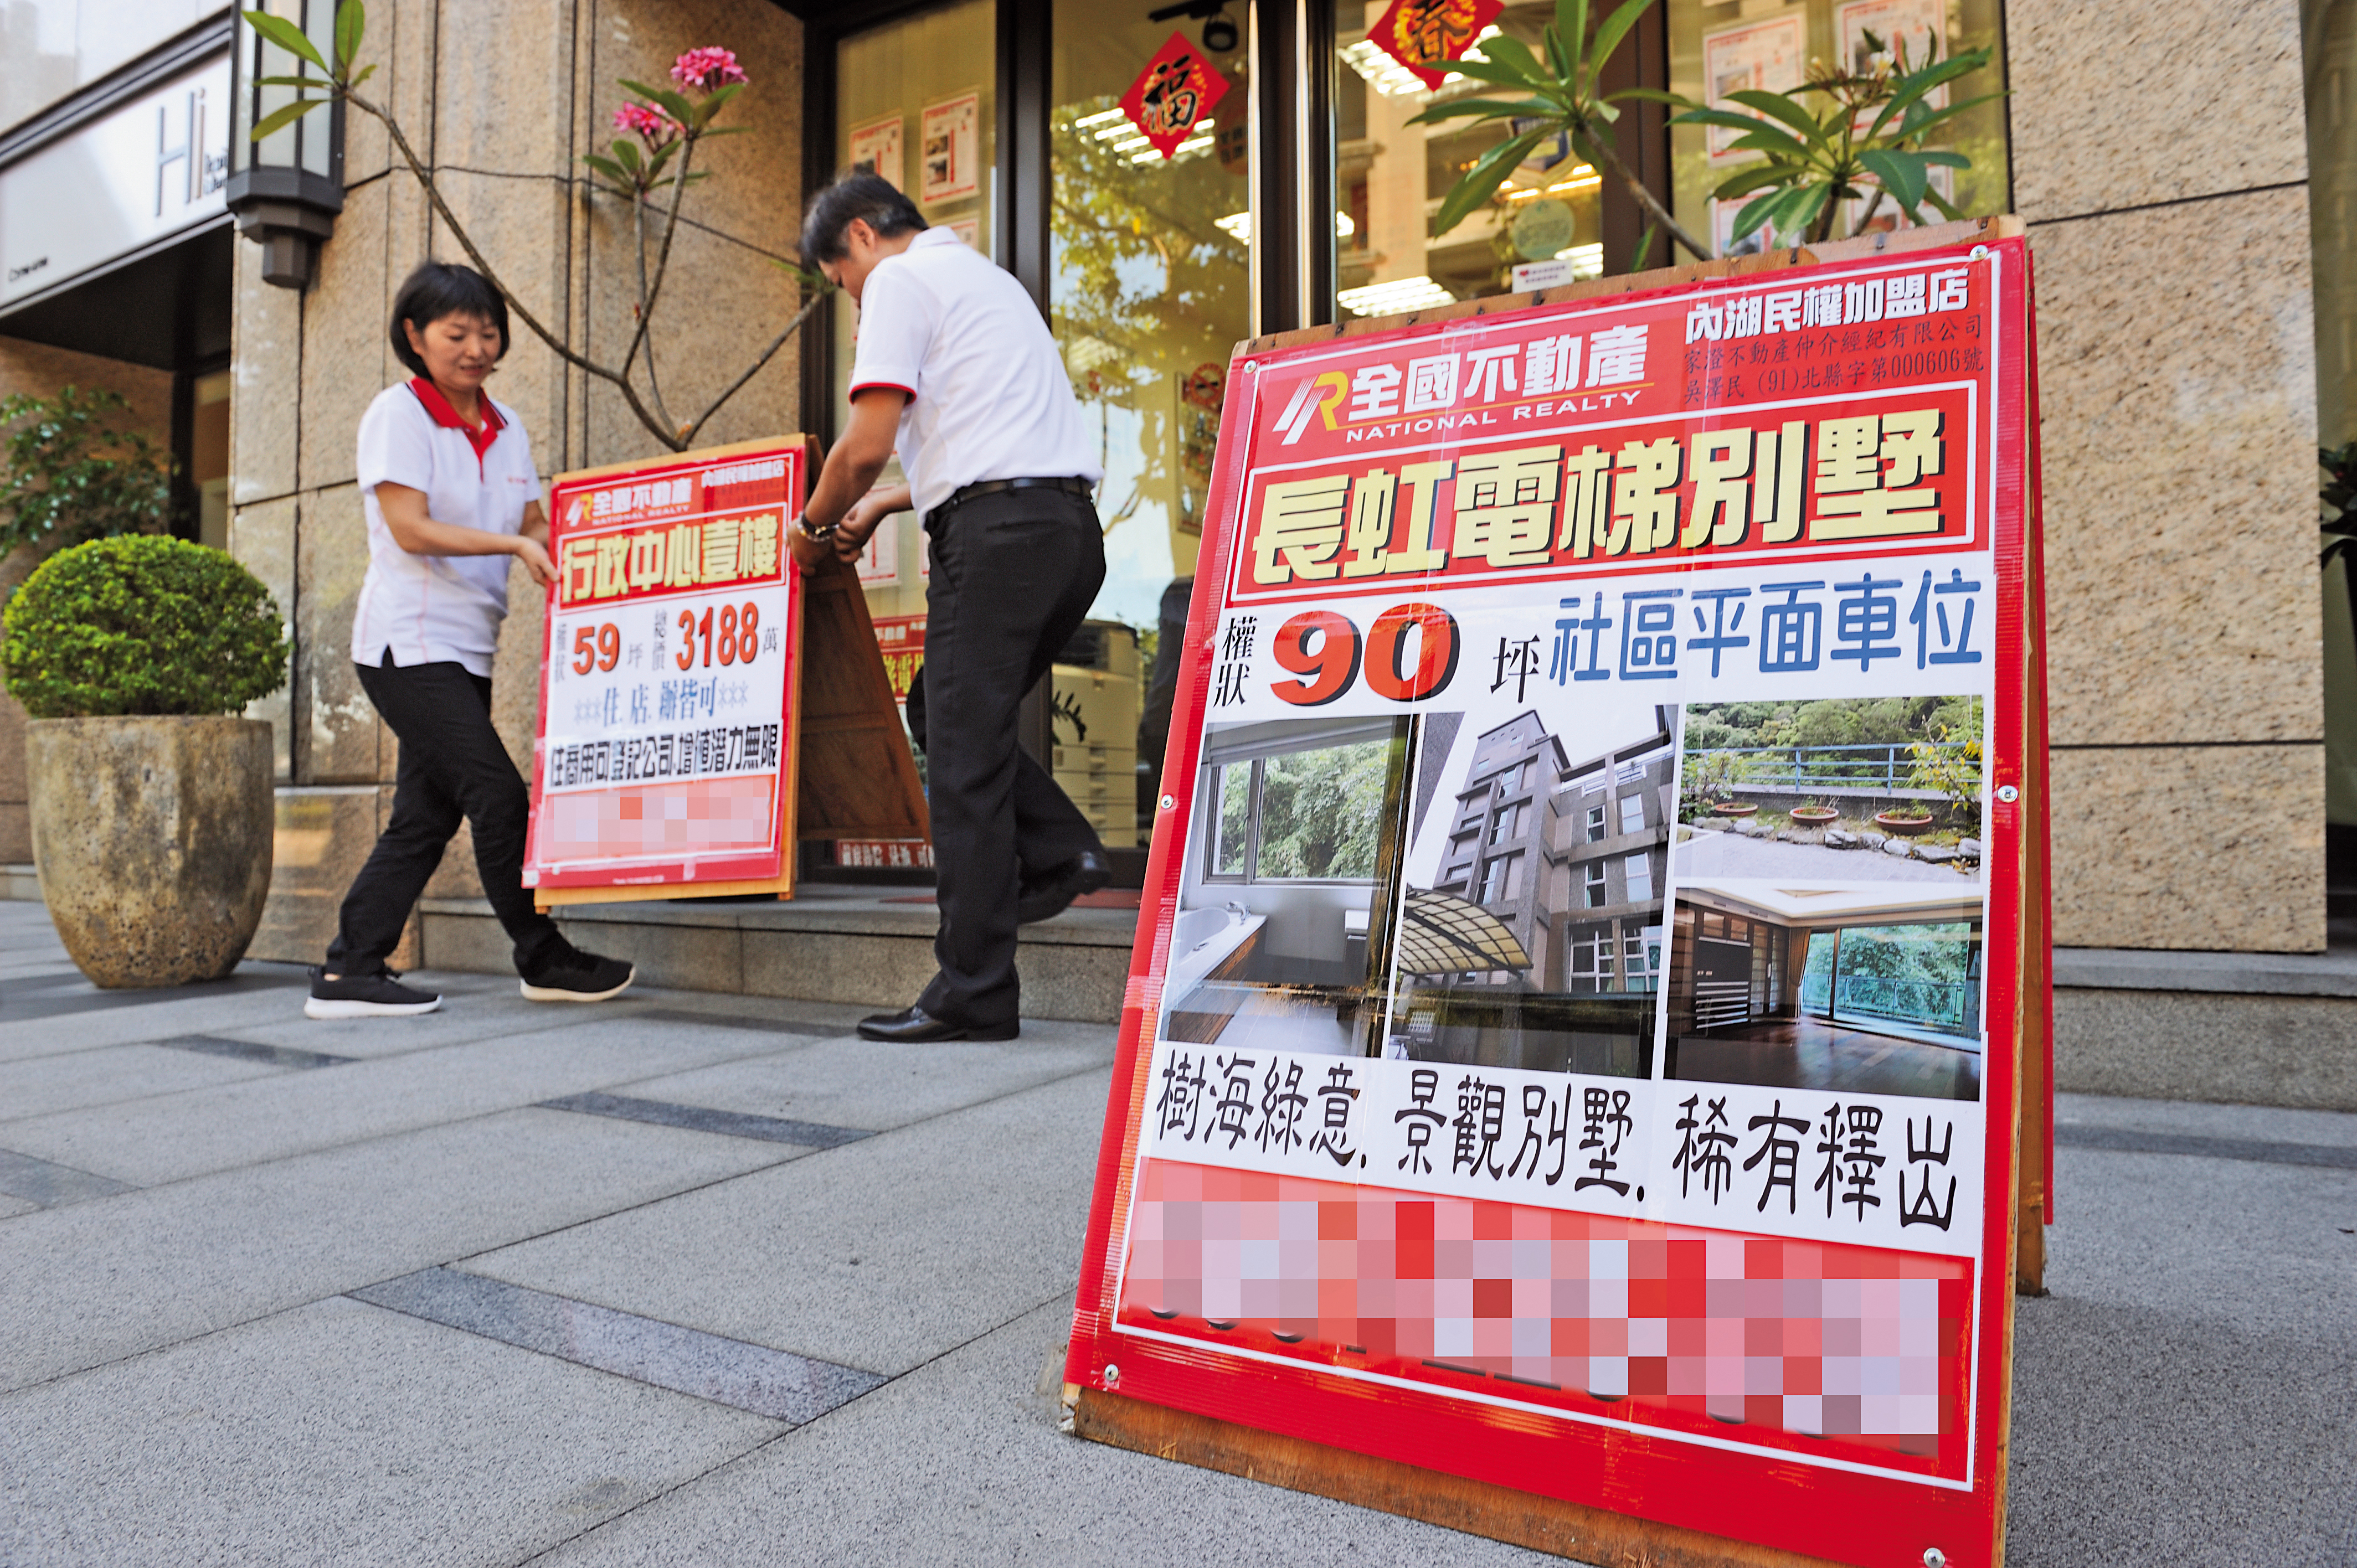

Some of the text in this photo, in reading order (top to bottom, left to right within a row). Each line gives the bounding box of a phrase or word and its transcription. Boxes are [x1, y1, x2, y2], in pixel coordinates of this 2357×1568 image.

[1141, 54, 1198, 135] 福
[1685, 268, 1969, 345] 內湖民權加盟店
[1348, 324, 1649, 422] 全國不動產
[1346, 390, 1642, 443] NATIONAL REALTY
[592, 477, 693, 517] 全國不動產
[1250, 407, 1946, 587] 長虹電梯別墅
[562, 513, 779, 604] 行政中心壹樓
[572, 622, 621, 675] 59
[676, 600, 760, 671] 3188
[1213, 616, 1258, 709] 權狀
[1269, 601, 1461, 707] 90
[1490, 634, 1541, 704] 坪
[1548, 566, 1983, 688] 社區平面車位
[1672, 1091, 1955, 1232] 稀有釋出
